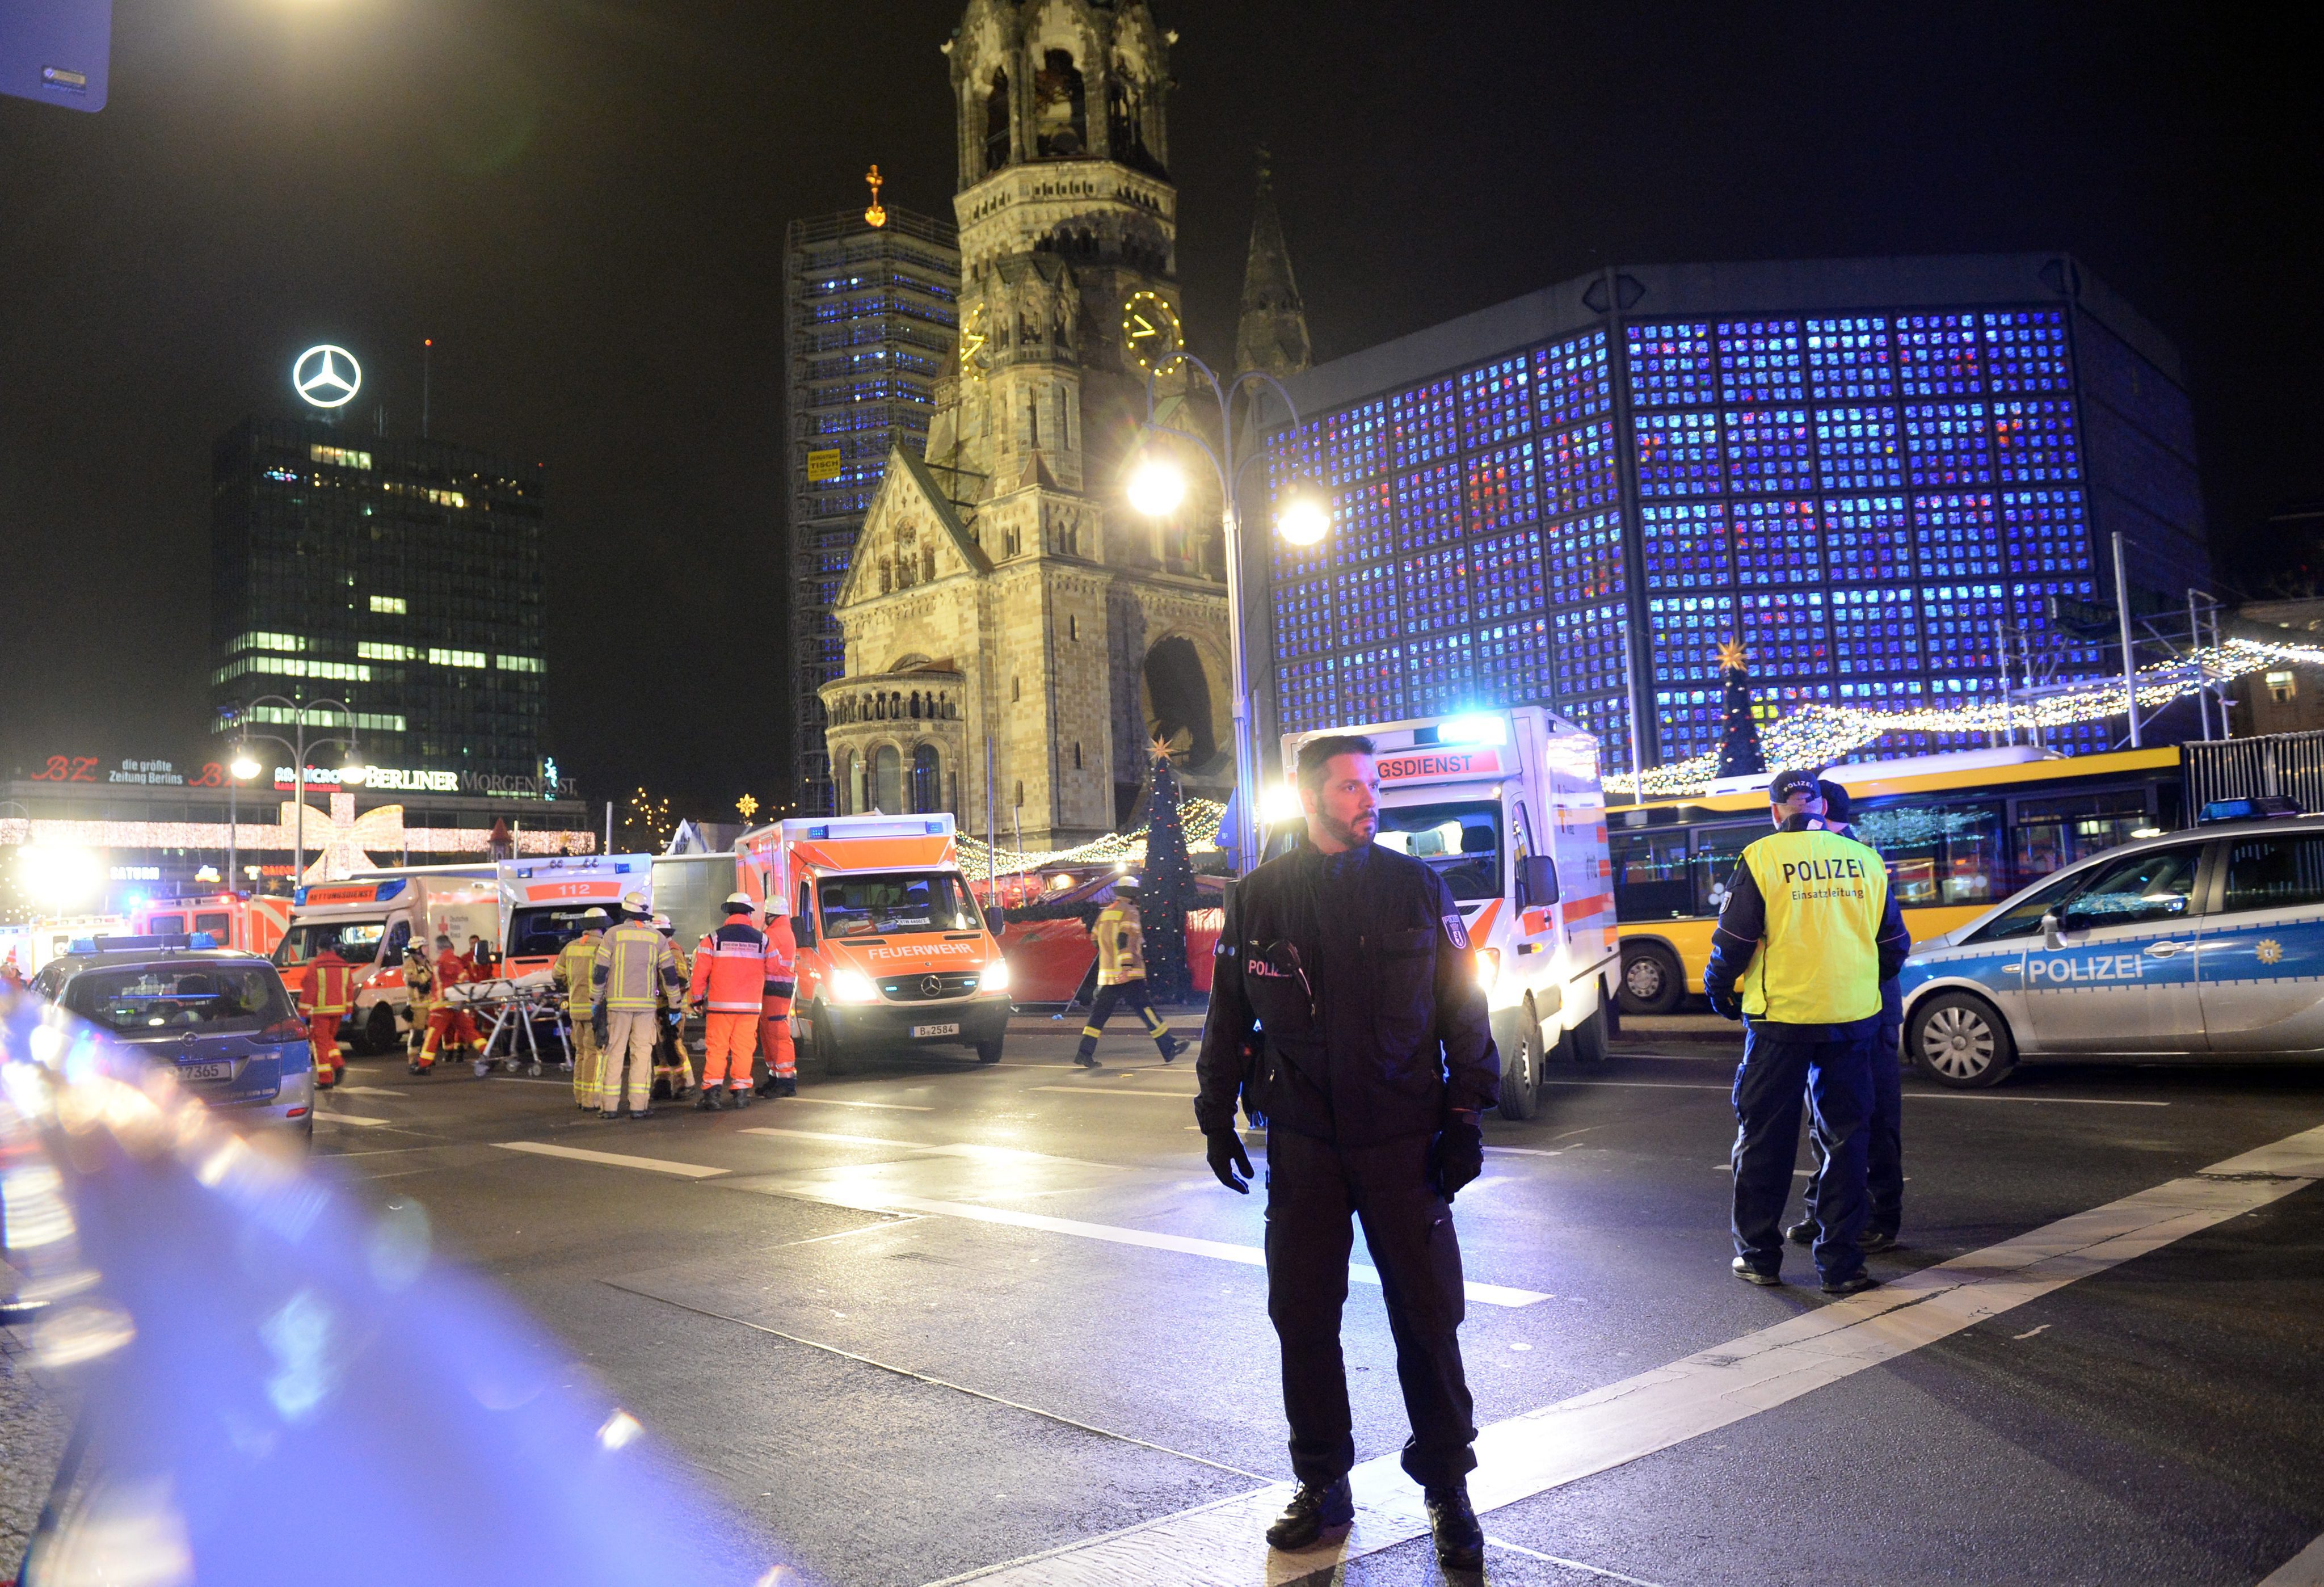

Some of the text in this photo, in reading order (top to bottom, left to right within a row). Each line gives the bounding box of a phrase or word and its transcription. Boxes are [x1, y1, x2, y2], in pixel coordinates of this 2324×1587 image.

[122, 759, 172, 773] die größte
[1378, 755, 1472, 778] GSDIENST
[108, 770, 183, 785] Zeitung Berlins
[365, 765, 459, 791] BERLINER
[461, 771, 576, 794] MORGENPOST
[1783, 780, 1813, 792] POLIZEI
[110, 866, 160, 881] SATURN
[1782, 858, 1866, 884] POLIZEI
[558, 884, 591, 895] 112
[1792, 888, 1864, 900] Einsatzleitung
[868, 943, 975, 960] FEUERWEHR
[1248, 959, 1292, 977] POLI
[2029, 954, 2143, 983] POLIZEI
[920, 1025, 953, 1035] B 2584
[185, 1064, 219, 1079] 7365
